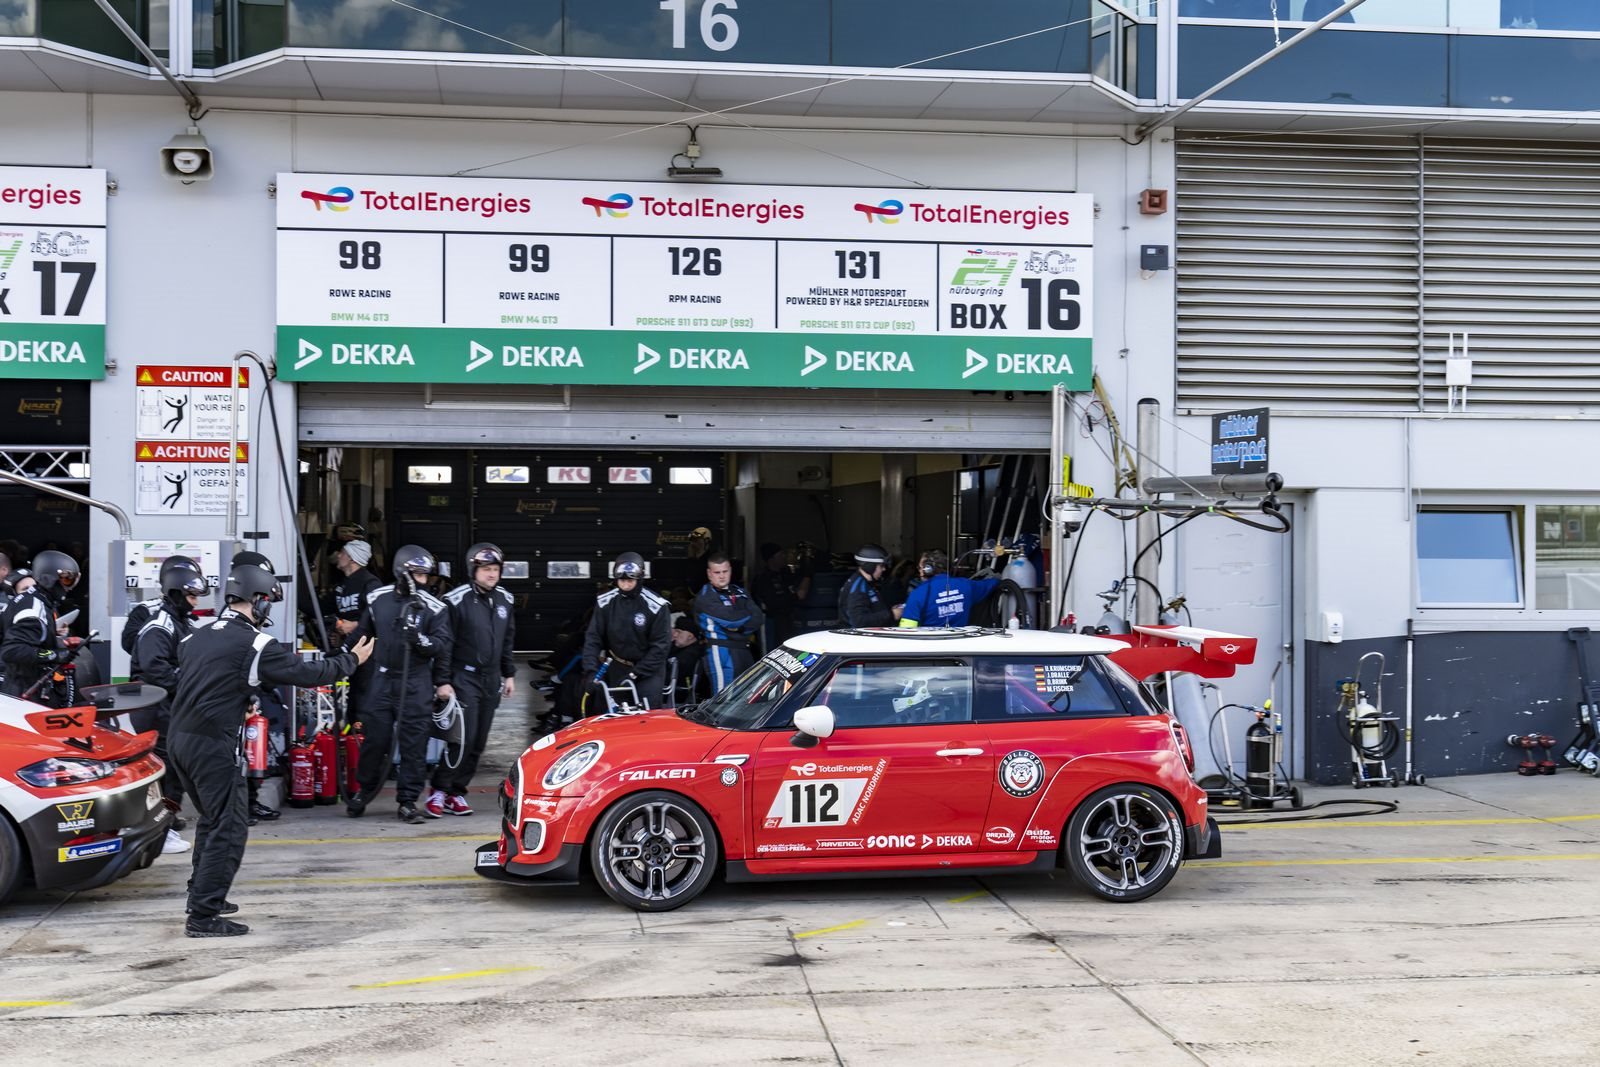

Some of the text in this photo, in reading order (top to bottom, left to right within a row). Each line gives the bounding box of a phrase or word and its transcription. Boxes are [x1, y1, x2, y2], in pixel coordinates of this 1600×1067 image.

[660, 0, 739, 51] 16
[360, 190, 531, 217] TotalEnergies
[640, 197, 804, 223] TotalEnergies
[909, 204, 1069, 230] TotalEnergies
[339, 240, 381, 269] 98
[509, 244, 550, 272] 99
[668, 247, 722, 276] 126
[834, 251, 880, 279] 131
[33, 261, 96, 316] 17
[329, 289, 391, 298] ROWE RACING
[499, 292, 560, 301] ROWE RACING
[809, 286, 907, 297] MÜHLNER MOTORSPORT
[949, 286, 1004, 297] nürburgring
[669, 295, 721, 304] RPM RACING
[786, 297, 929, 307] POWERED BY H&R SPEZIALFEDERN
[1021, 278, 1080, 330] 16
[331, 313, 389, 322] BMW M4 GT3
[501, 315, 558, 324] BMW M4 GT3
[636, 318, 753, 328] PORSCHE 911 GT3 CUP (992)
[800, 320, 915, 331] PORSCHE 911 GT3 CUP (992)
[951, 303, 1007, 329] BOX
[0, 341, 86, 363] DEKRA
[332, 344, 415, 366] DEKRA
[503, 346, 584, 368] DEKRA
[669, 348, 750, 369] DEKRA
[836, 351, 914, 372] DEKRA
[997, 354, 1073, 374] DEKRA
[162, 371, 224, 383] CAUTION
[154, 446, 230, 459] ACHTUNG
[126, 576, 138, 588] 17
[207, 576, 219, 588] 16
[818, 764, 873, 773] TotalEnergies
[1003, 751, 1040, 766] BULLDOG
[852, 758, 887, 825] ADAC NORDRHEIN
[789, 783, 839, 823] 112
[58, 819, 95, 829] BAUER
[936, 835, 973, 847] DEKRA
